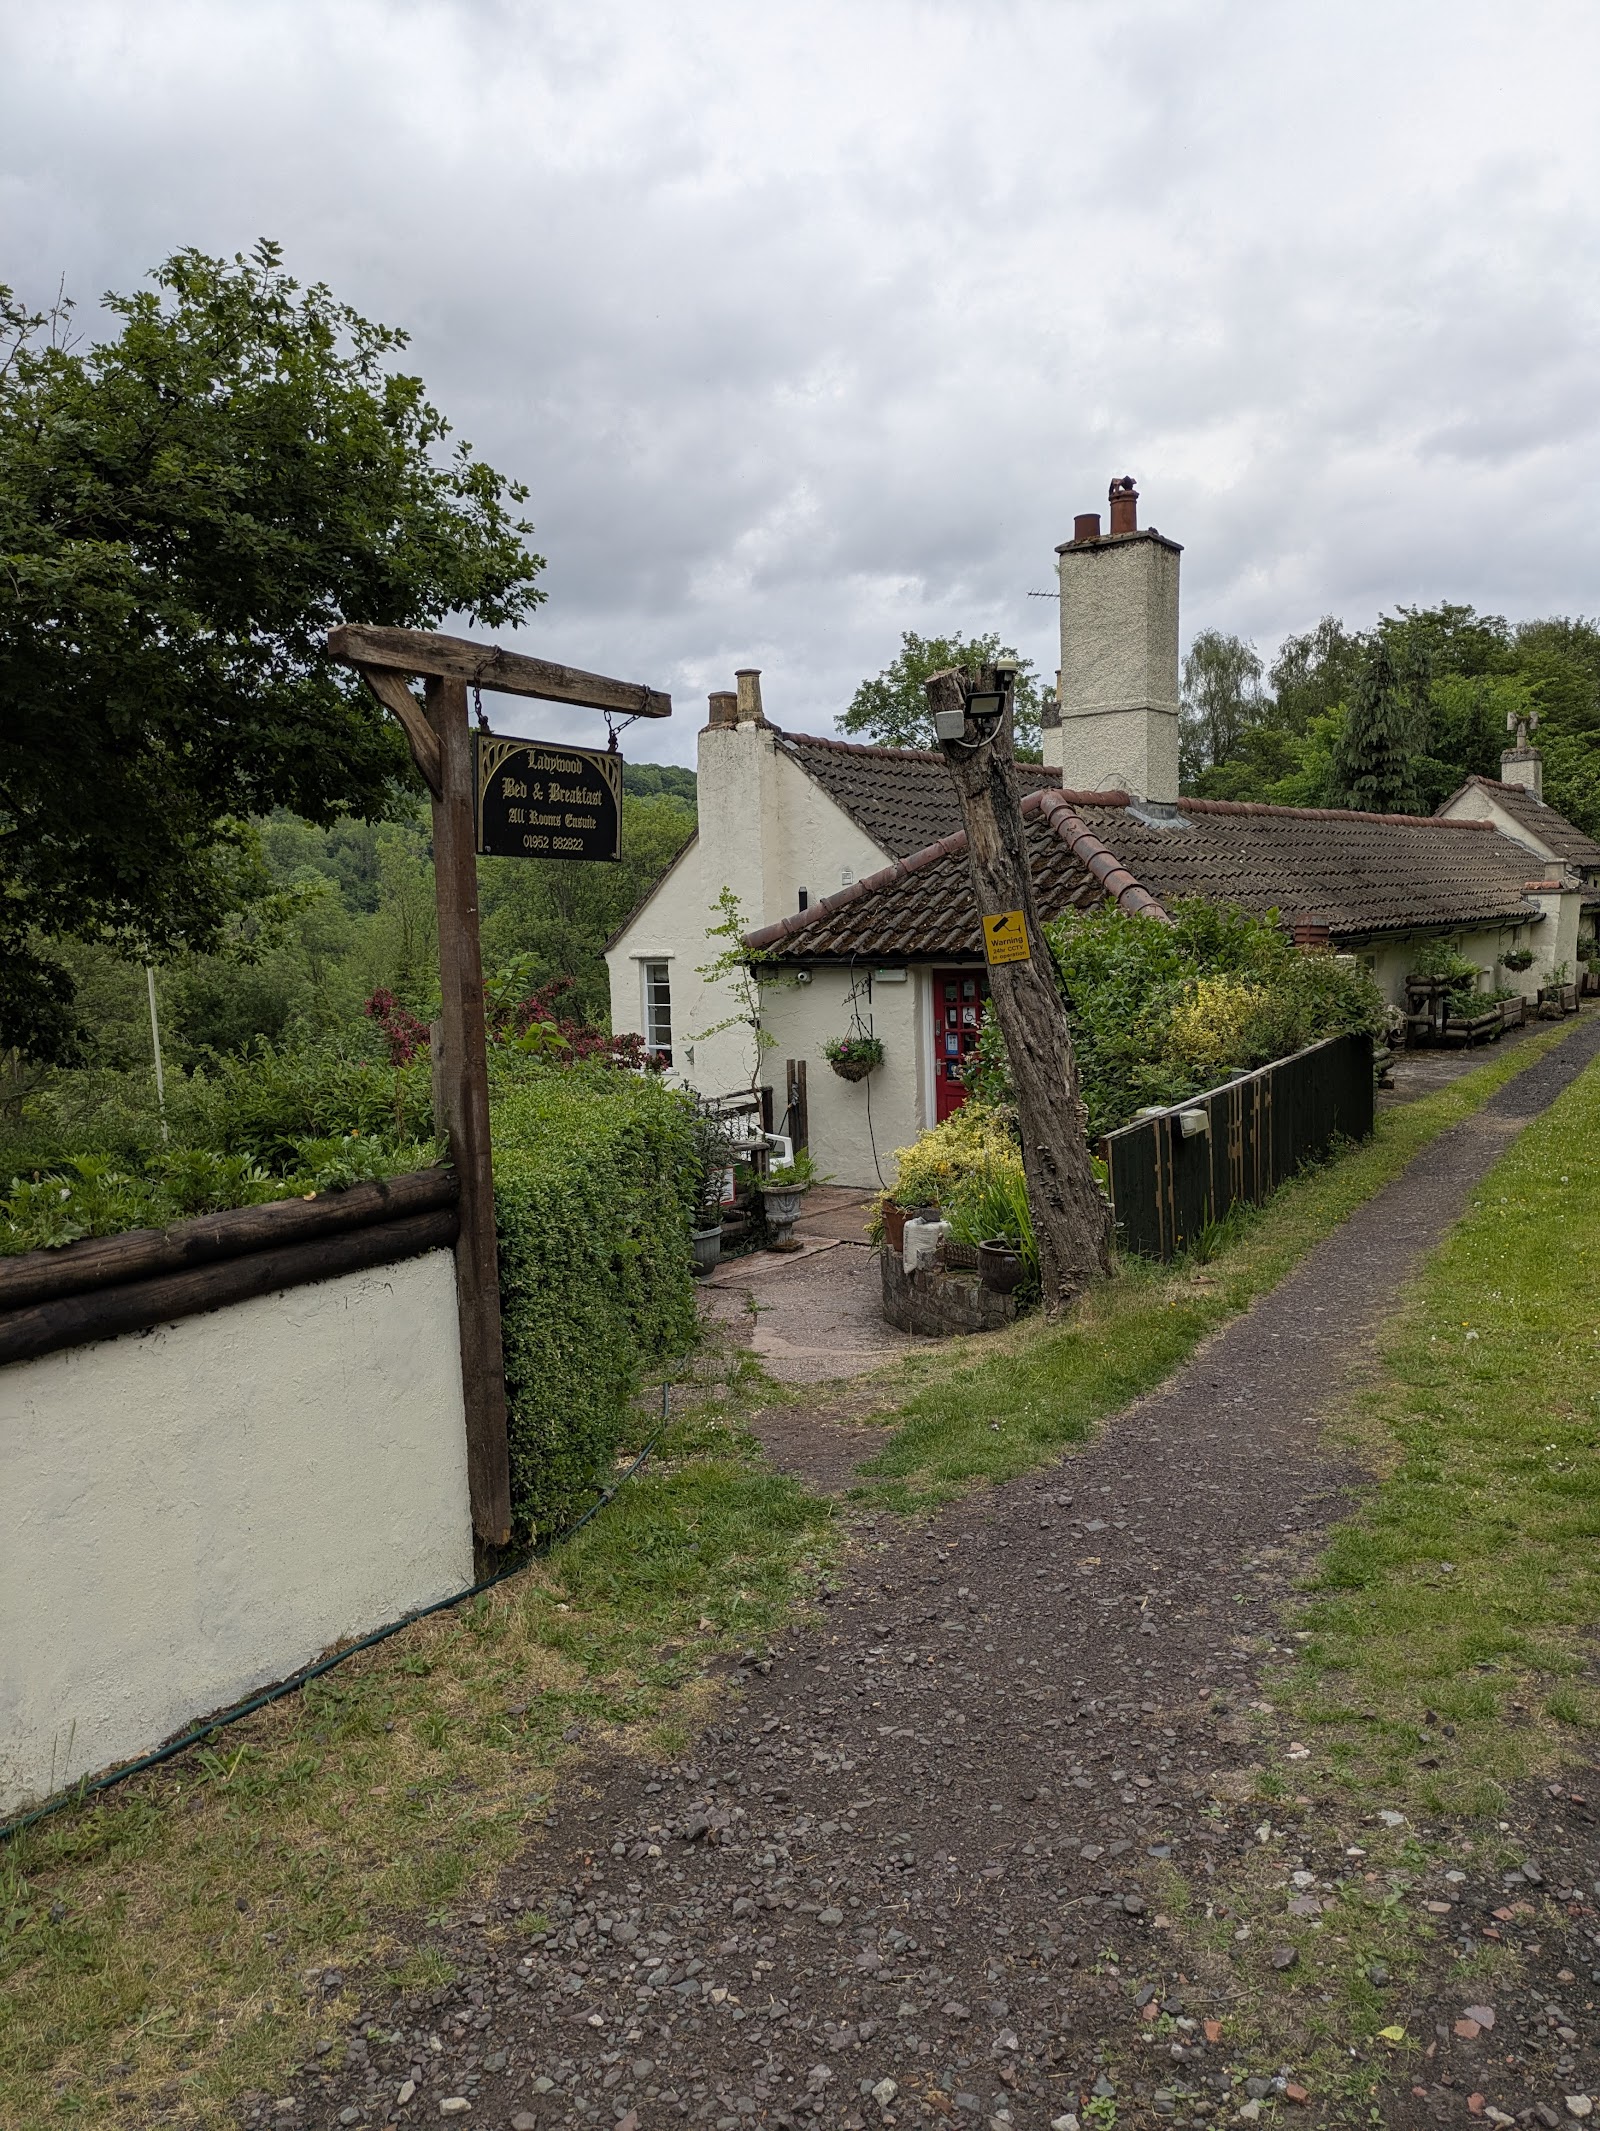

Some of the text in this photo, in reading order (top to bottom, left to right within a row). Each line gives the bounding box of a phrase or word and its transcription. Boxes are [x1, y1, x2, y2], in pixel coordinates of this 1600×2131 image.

[527, 749, 583, 774] Ladywood
[502, 777, 603, 805] Bed & Breakfast
[508, 808, 597, 829] All Rooms Ensuite
[523, 834, 584, 851] 01952 882822
[991, 937, 1023, 946] Warning
[1000, 951, 1026, 959] operation
